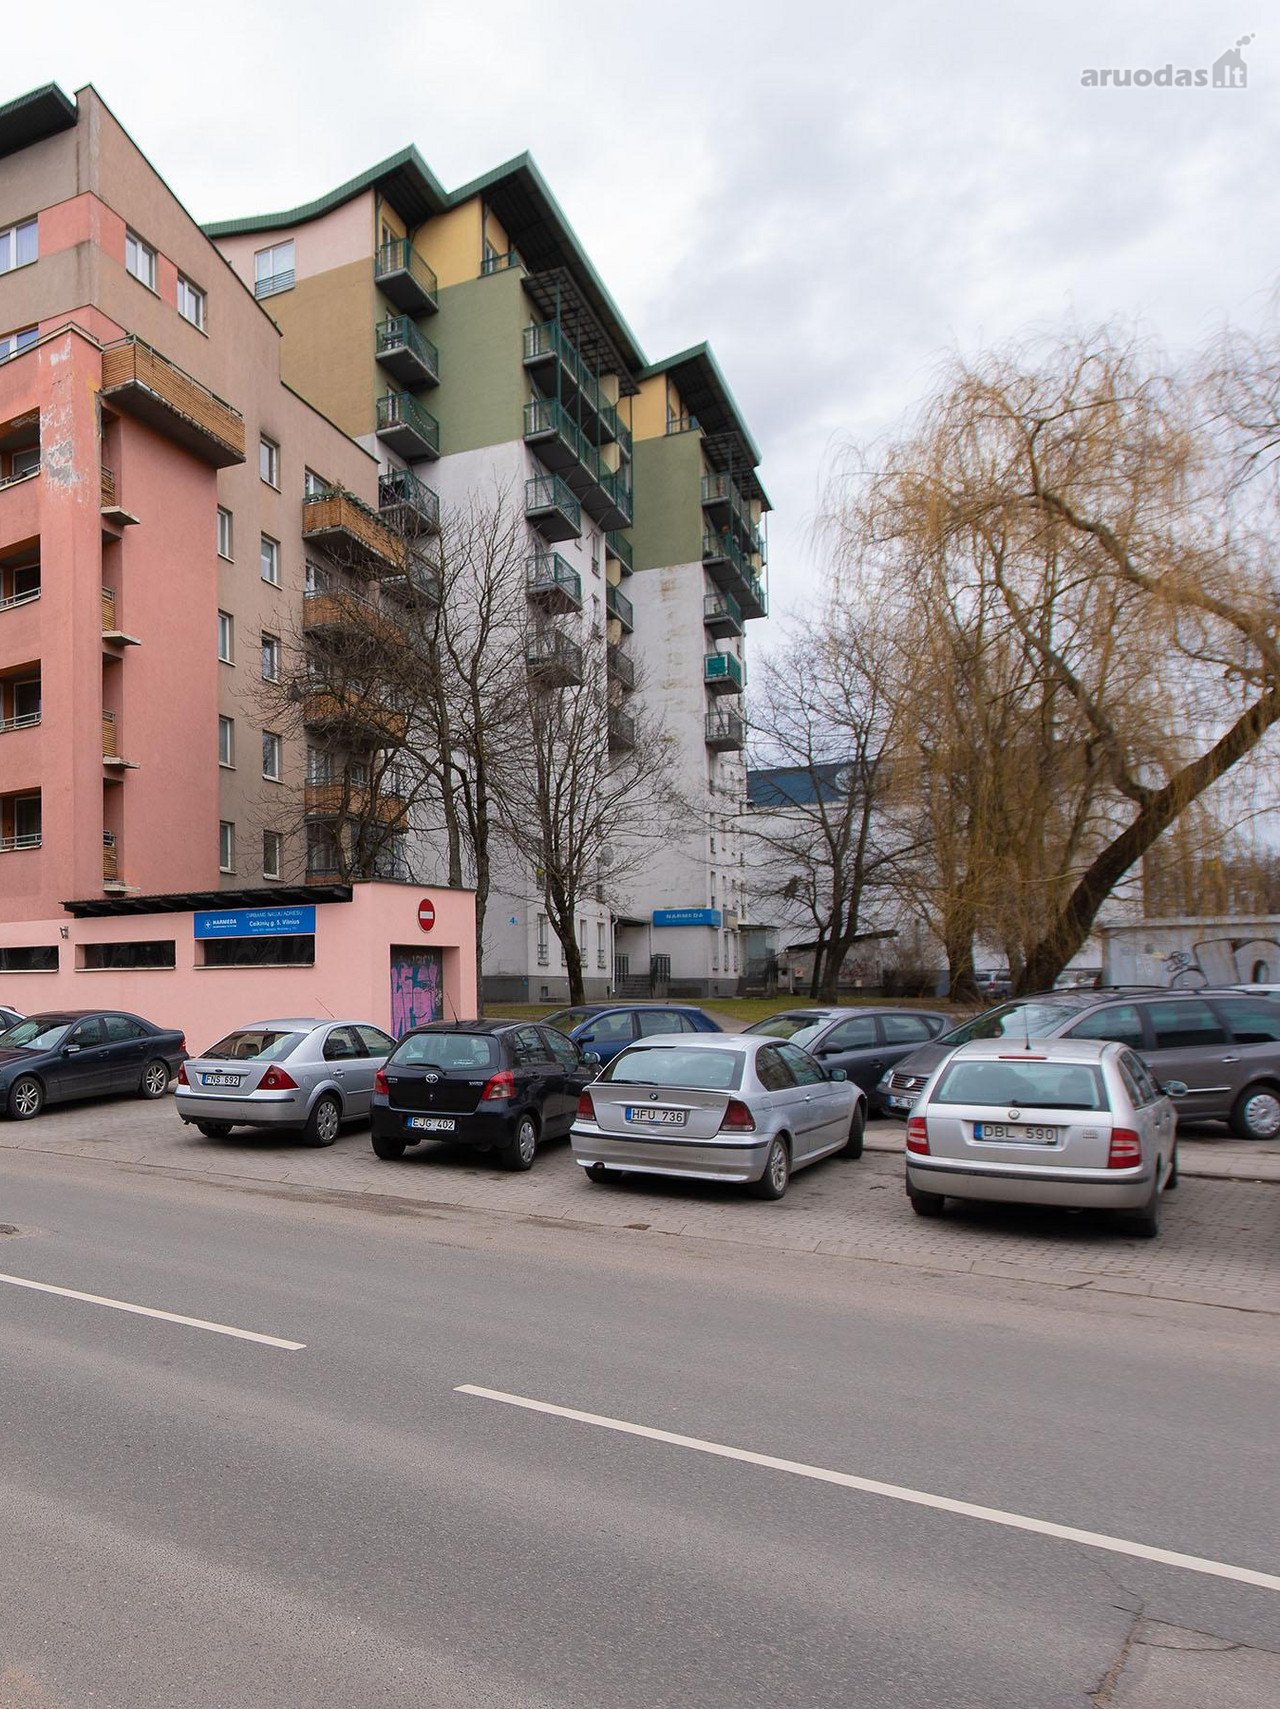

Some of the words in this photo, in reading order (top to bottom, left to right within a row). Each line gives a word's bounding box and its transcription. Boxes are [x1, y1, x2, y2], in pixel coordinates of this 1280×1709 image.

[207, 1074, 221, 1083] FNS
[224, 1075, 239, 1085] 692
[632, 1109, 656, 1120] HFU
[662, 1111, 683, 1122] 736
[413, 1117, 432, 1128] EJG
[437, 1120, 454, 1130] 402
[984, 1125, 1016, 1138] DBL
[1026, 1127, 1054, 1140] 590
